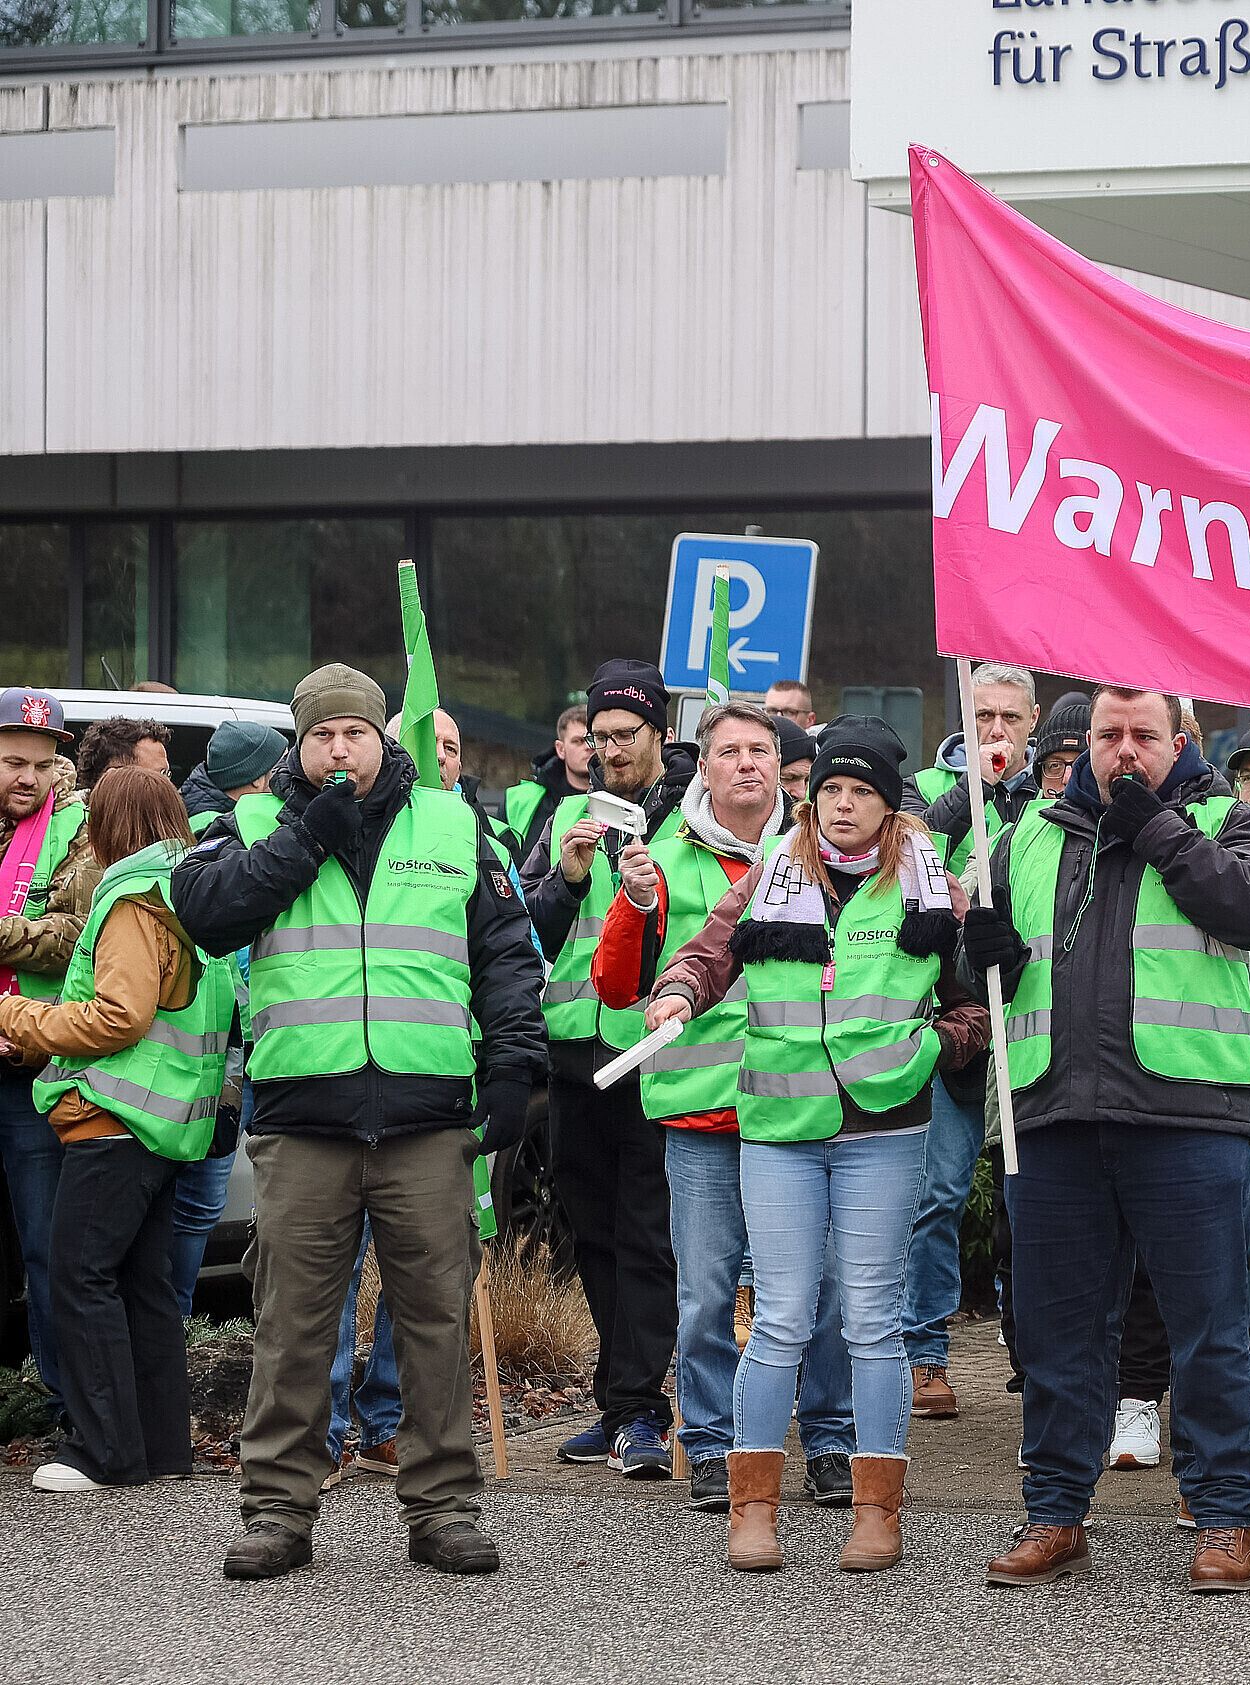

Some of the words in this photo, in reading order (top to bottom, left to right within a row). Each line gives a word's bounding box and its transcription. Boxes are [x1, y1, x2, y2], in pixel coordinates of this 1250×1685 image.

[987, 30, 1072, 87] für
[687, 557, 767, 671] P
[388, 859, 434, 871] VDStra.
[847, 930, 896, 941] VDStra.
